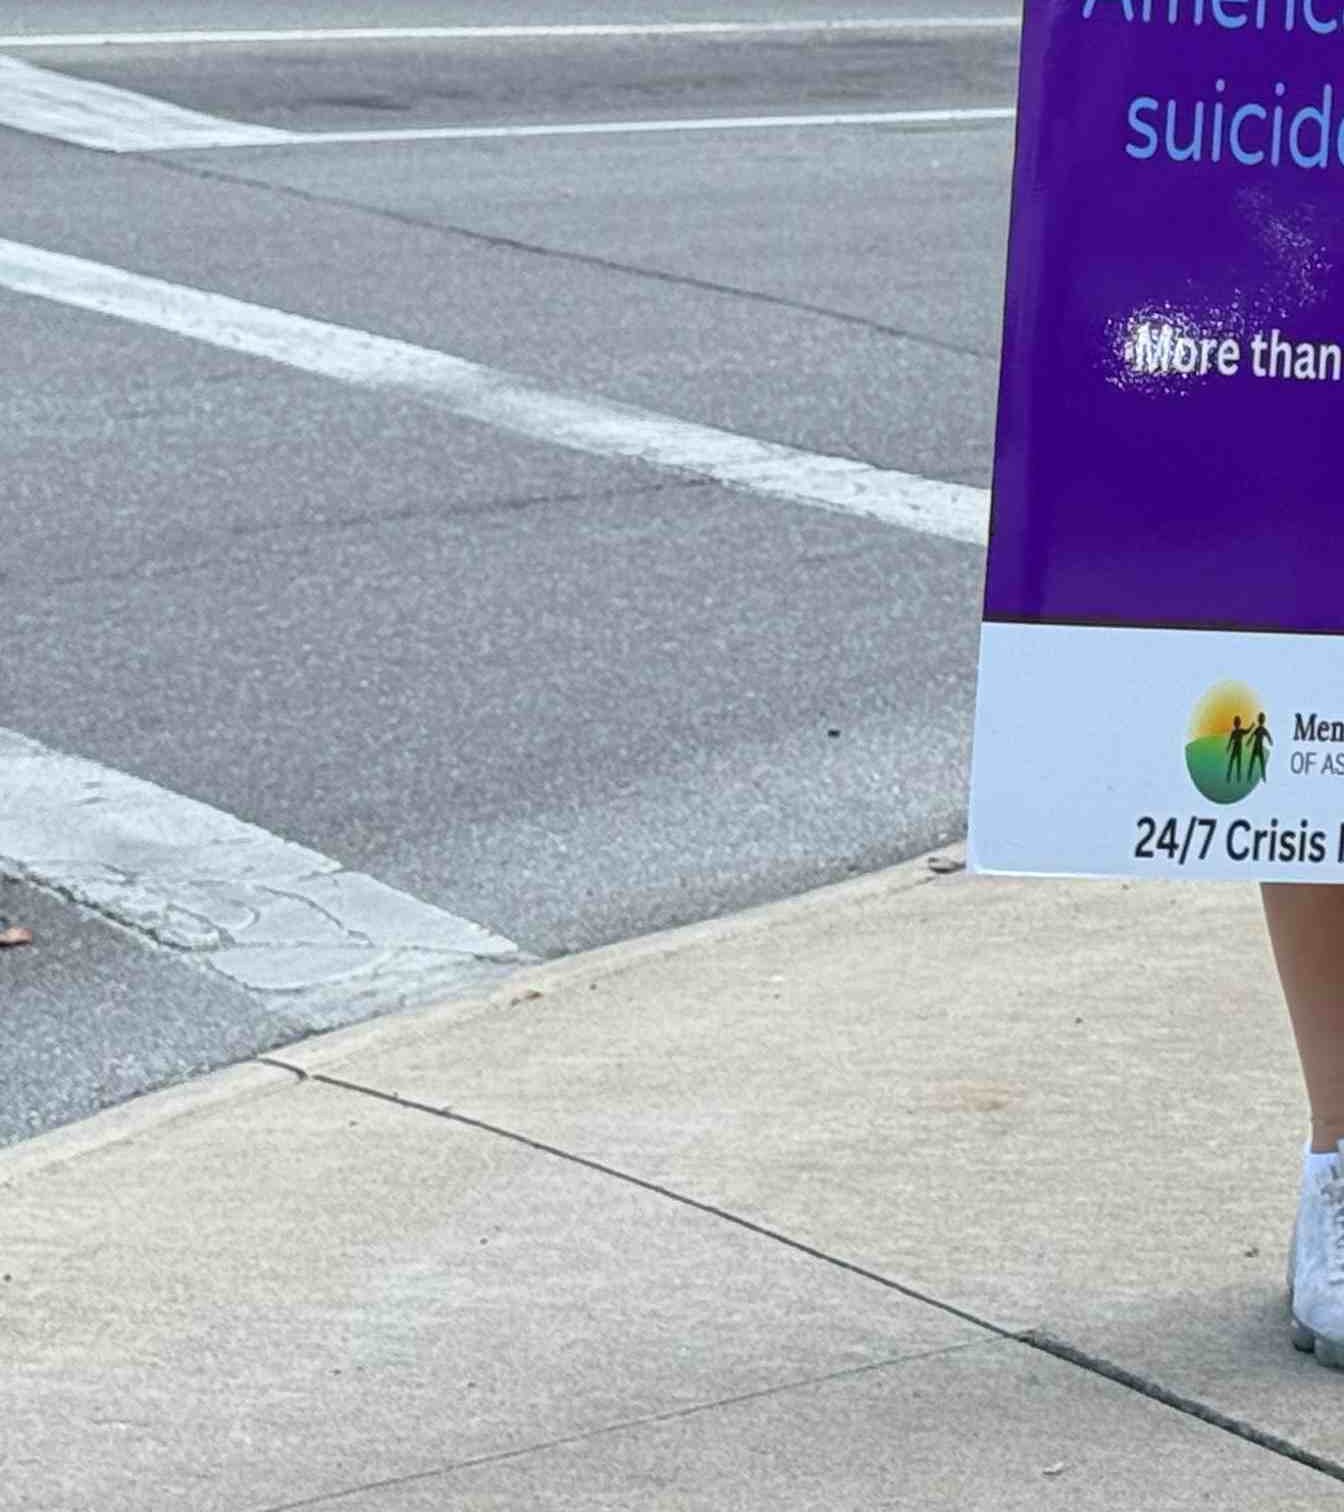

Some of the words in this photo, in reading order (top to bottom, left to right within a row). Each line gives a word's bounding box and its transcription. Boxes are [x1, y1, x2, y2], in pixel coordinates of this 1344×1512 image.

[1134, 321, 1241, 376] More
[1250, 328, 1341, 379] than
[1291, 751, 1316, 775] OF
[1134, 815, 1218, 866] 24/7
[1225, 818, 1327, 865] Crisis
